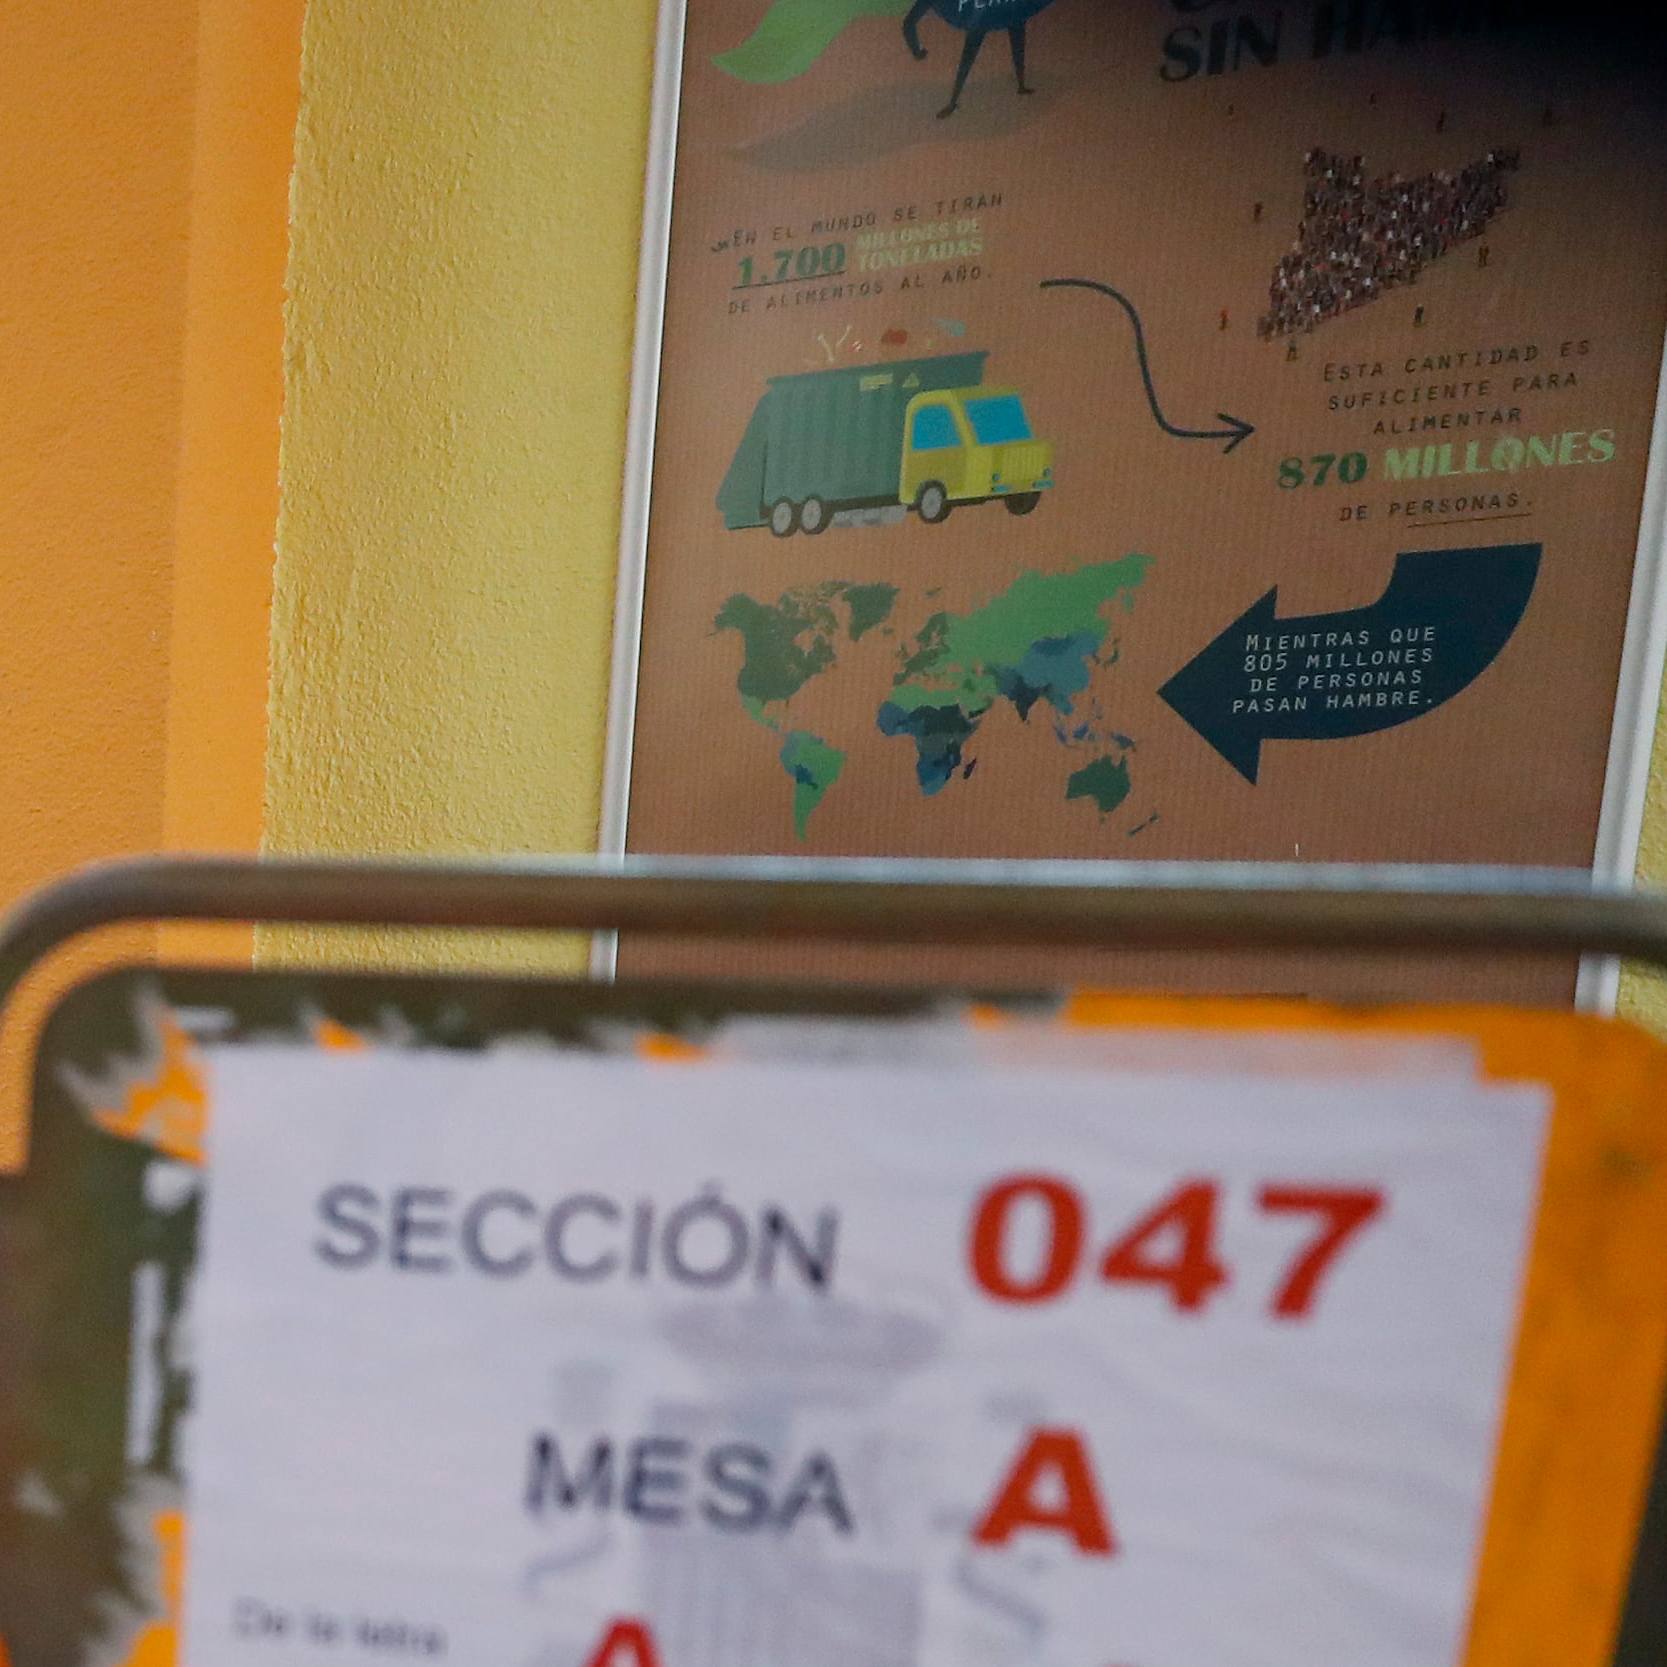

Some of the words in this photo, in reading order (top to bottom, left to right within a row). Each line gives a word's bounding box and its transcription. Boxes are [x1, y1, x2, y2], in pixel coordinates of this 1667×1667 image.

[1159, 10, 1283, 82] SIN
[772, 226, 794, 241] EL
[810, 211, 877, 234] MUNDO
[893, 206, 917, 222] SE
[935, 194, 1003, 217] TIRAN
[737, 242, 847, 288] 1.700
[855, 220, 950, 250] MILLONES
[858, 239, 983, 272] TONELADAS
[728, 300, 750, 315] DE
[766, 283, 883, 310] ALIMENTOS
[900, 275, 925, 290] AL
[941, 265, 992, 284] AÑO.
[1323, 361, 1383, 383] ESTA
[1404, 345, 1539, 375] CANTIDAD
[1560, 339, 1591, 358] ES
[1328, 379, 1490, 411] SUFICIENTE
[1512, 371, 1578, 392] PARA
[1372, 406, 1523, 436] ALIMENTAR
[1277, 451, 1368, 491] 870
[1383, 429, 1616, 481] MILLONES
[1339, 504, 1369, 523] DE
[1388, 492, 1534, 518] PERSONAS.
[1246, 631, 1369, 652] MIENTRAS
[1390, 625, 1437, 643] QUE
[1243, 652, 1289, 673] 805
[1306, 648, 1433, 668] MILLONES
[1250, 676, 1278, 693] DE
[1297, 670, 1422, 689] PERSONAS
[1232, 696, 1308, 714] PASAN
[1325, 690, 1435, 709] HAMBRE.
[313, 1178, 843, 1297] SECCIÓN
[965, 1172, 1390, 1321] 047
[525, 1430, 857, 1537] MESA
[972, 1427, 1118, 1559] A
